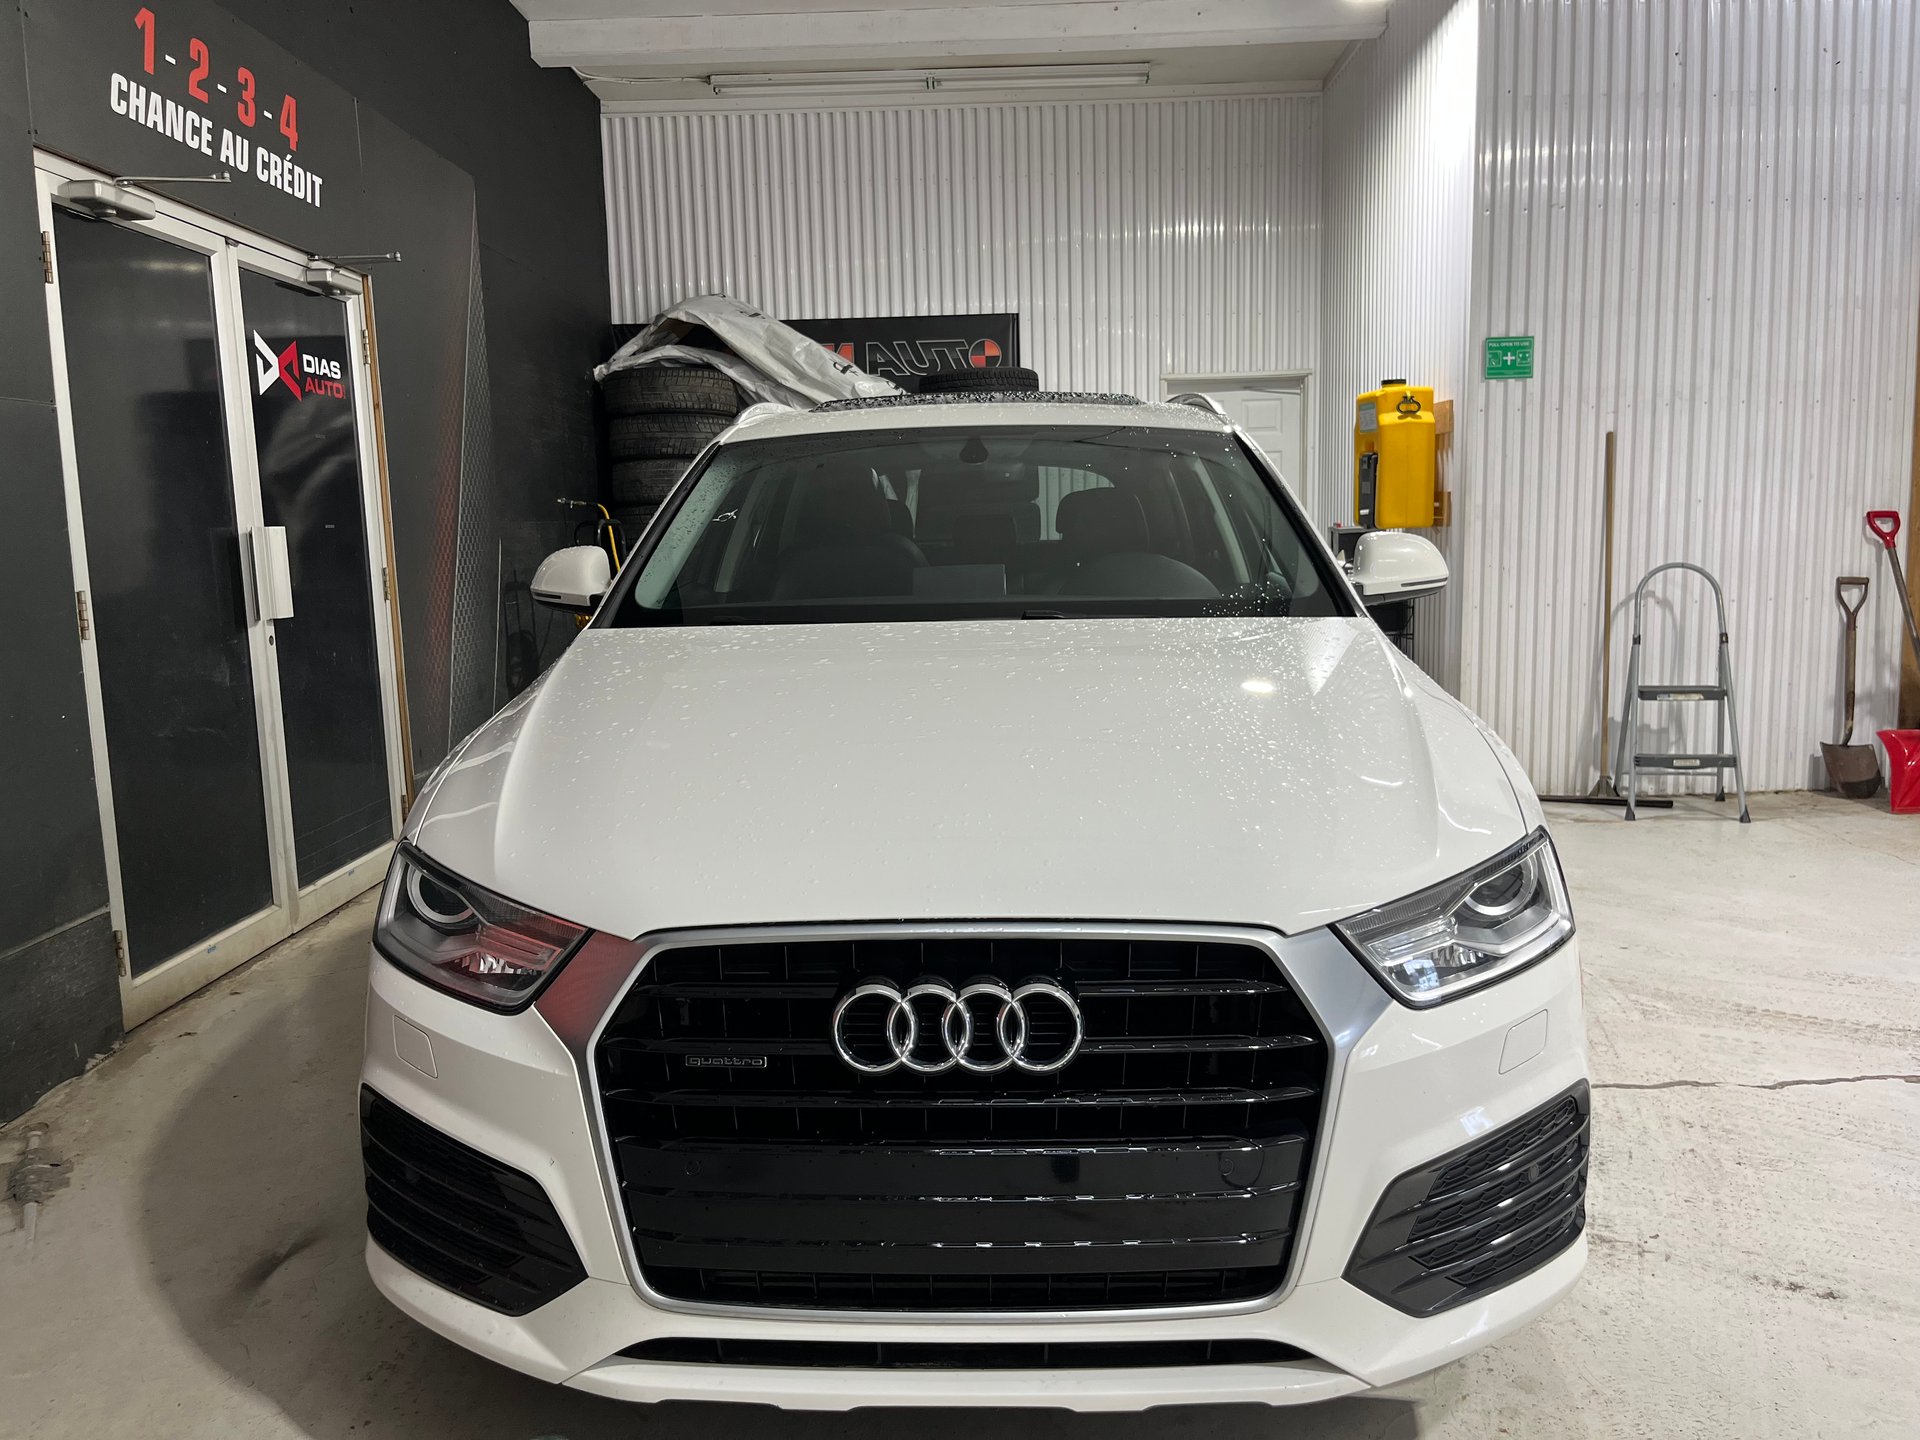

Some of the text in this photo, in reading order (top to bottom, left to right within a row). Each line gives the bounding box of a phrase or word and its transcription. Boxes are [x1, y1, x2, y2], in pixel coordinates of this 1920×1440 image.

[110, 72, 323, 208] CHANCE AU CRÉDIT
[302, 353, 342, 380] DIAS
[305, 376, 343, 399] AUTO
[689, 1056, 763, 1066] quattro
